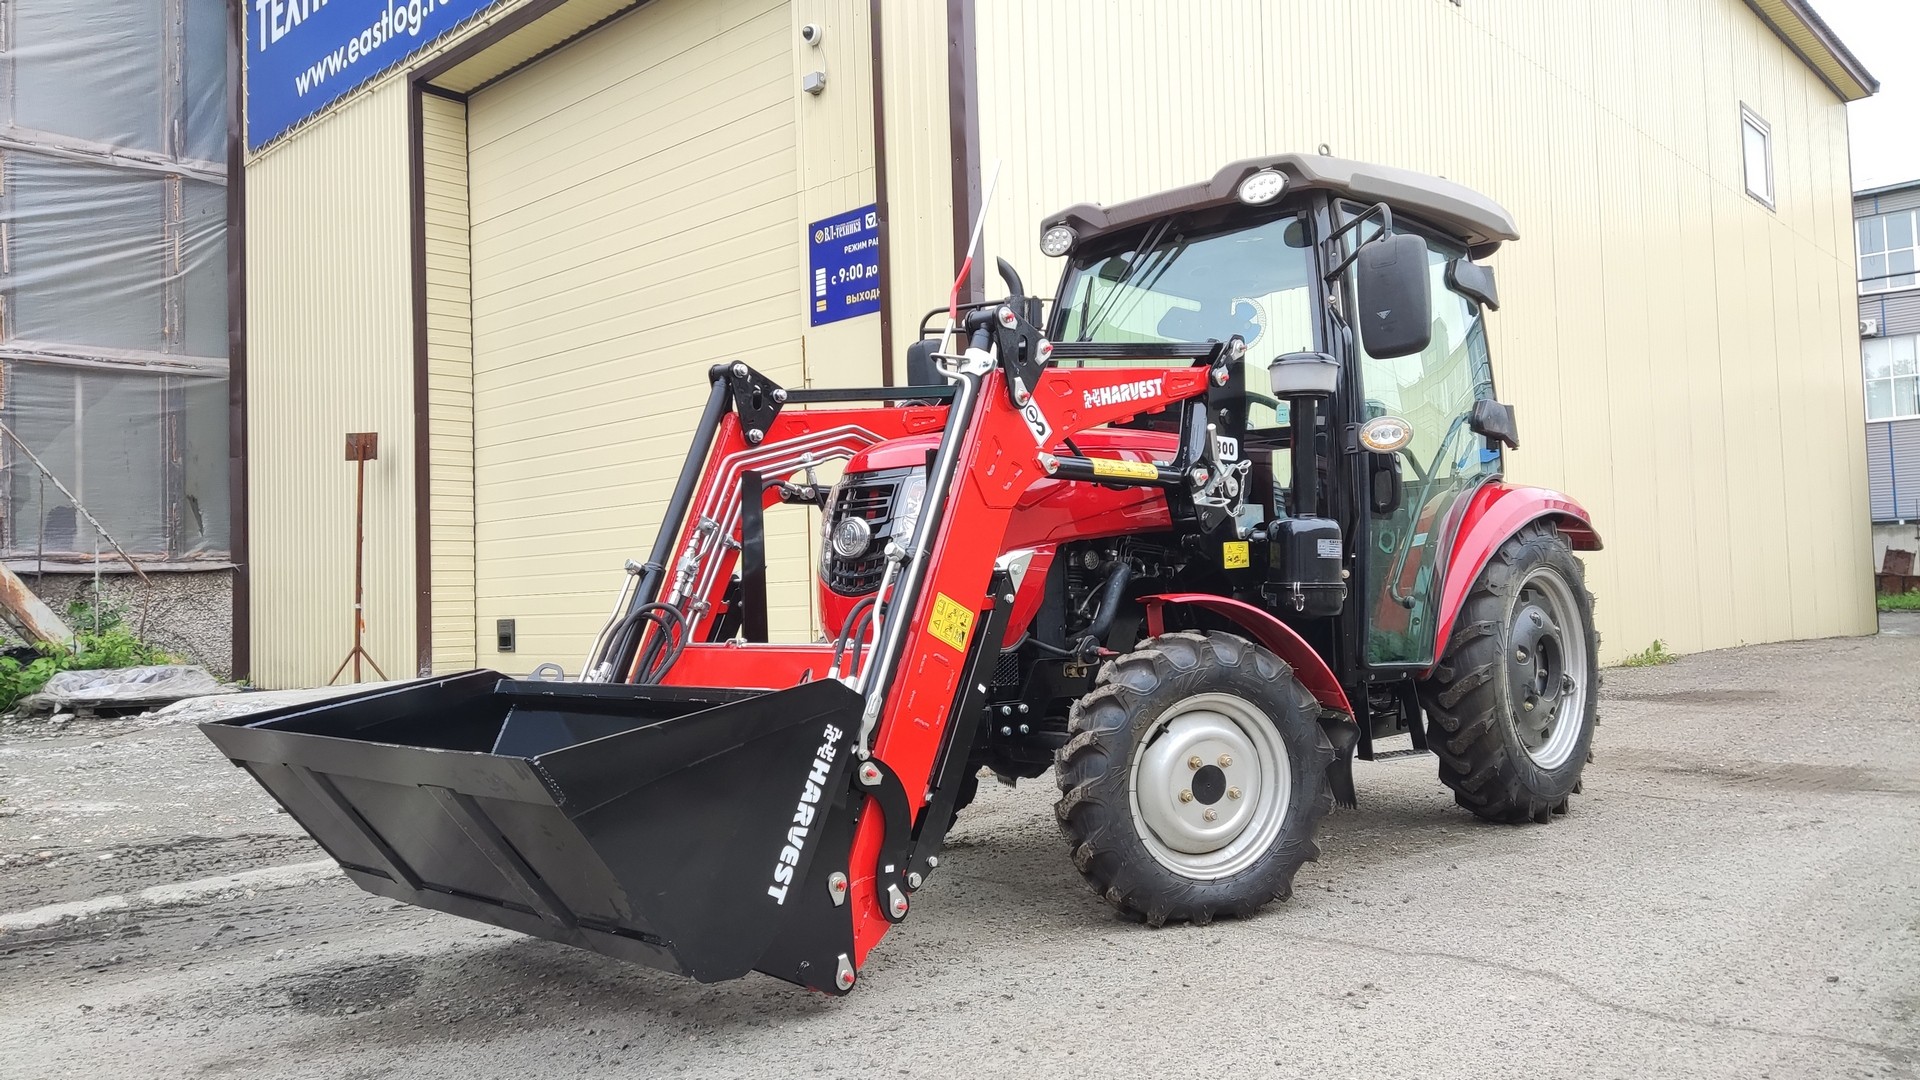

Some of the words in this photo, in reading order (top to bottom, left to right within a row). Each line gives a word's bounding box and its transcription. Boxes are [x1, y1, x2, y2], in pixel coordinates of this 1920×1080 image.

[256, 0, 328, 52] ТЕХ
[295, 0, 449, 97] www.eastlog.
[844, 240, 867, 254] РЕЖИМ
[831, 275, 837, 285] с
[839, 263, 863, 283] 9:00
[866, 264, 878, 278] до
[1100, 378, 1162, 406] HARVEST
[767, 758, 831, 906] HARVEST
